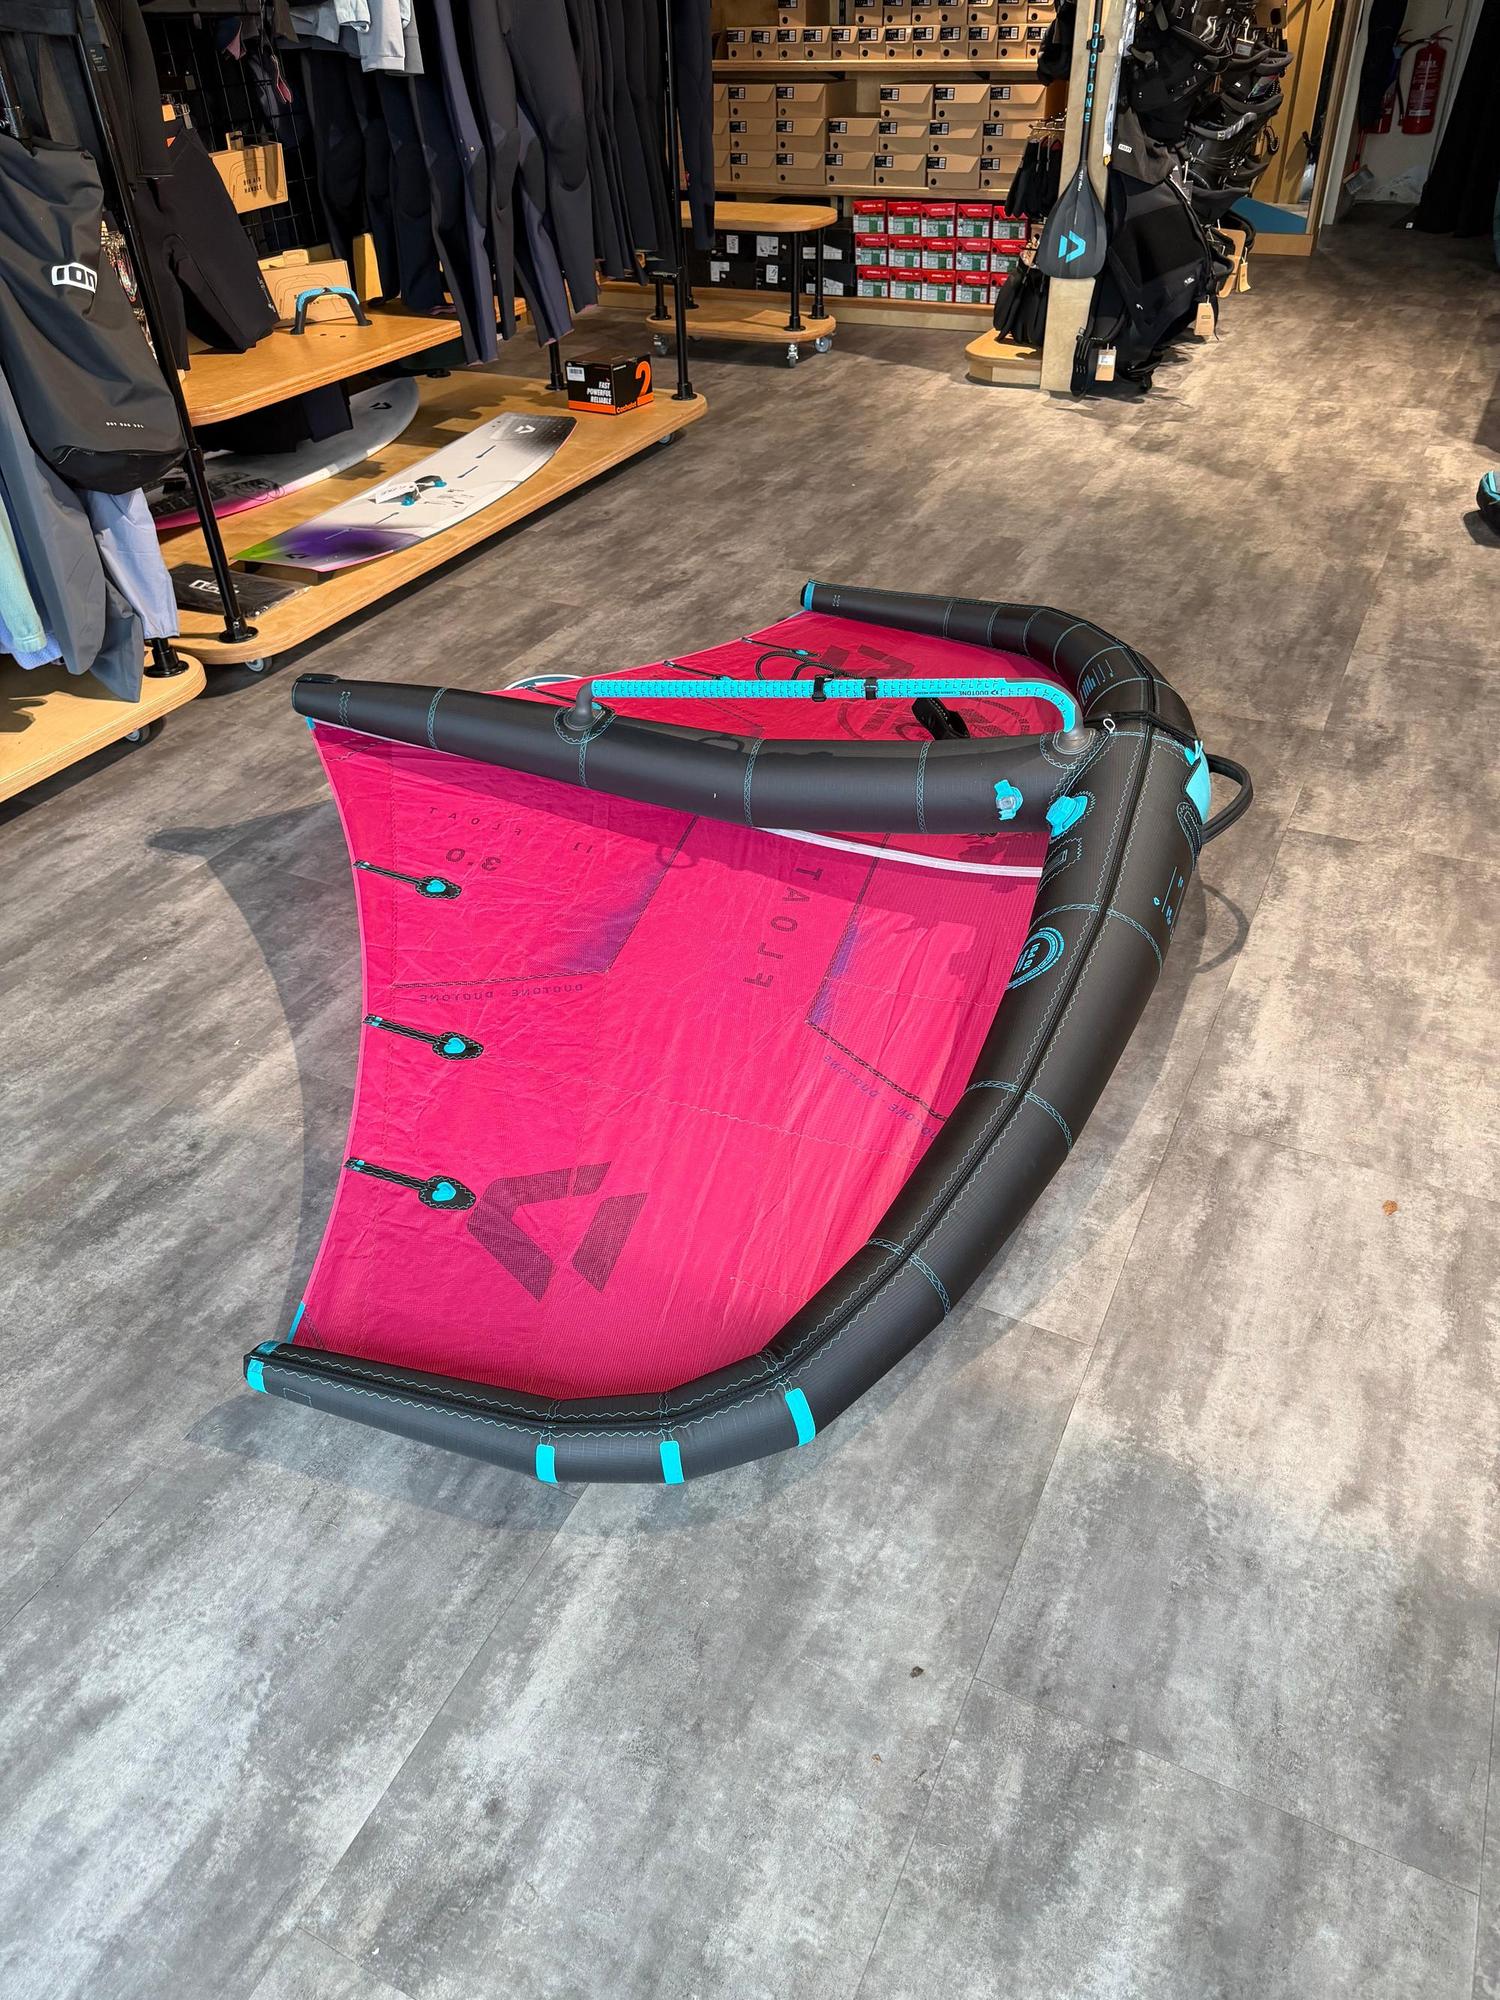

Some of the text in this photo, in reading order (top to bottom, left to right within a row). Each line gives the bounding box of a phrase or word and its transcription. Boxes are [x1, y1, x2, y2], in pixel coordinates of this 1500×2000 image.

[1084, 24, 1099, 121] DUOTONE
[587, 388, 611, 397] POWERFUL
[590, 396, 611, 404] RELIABLE
